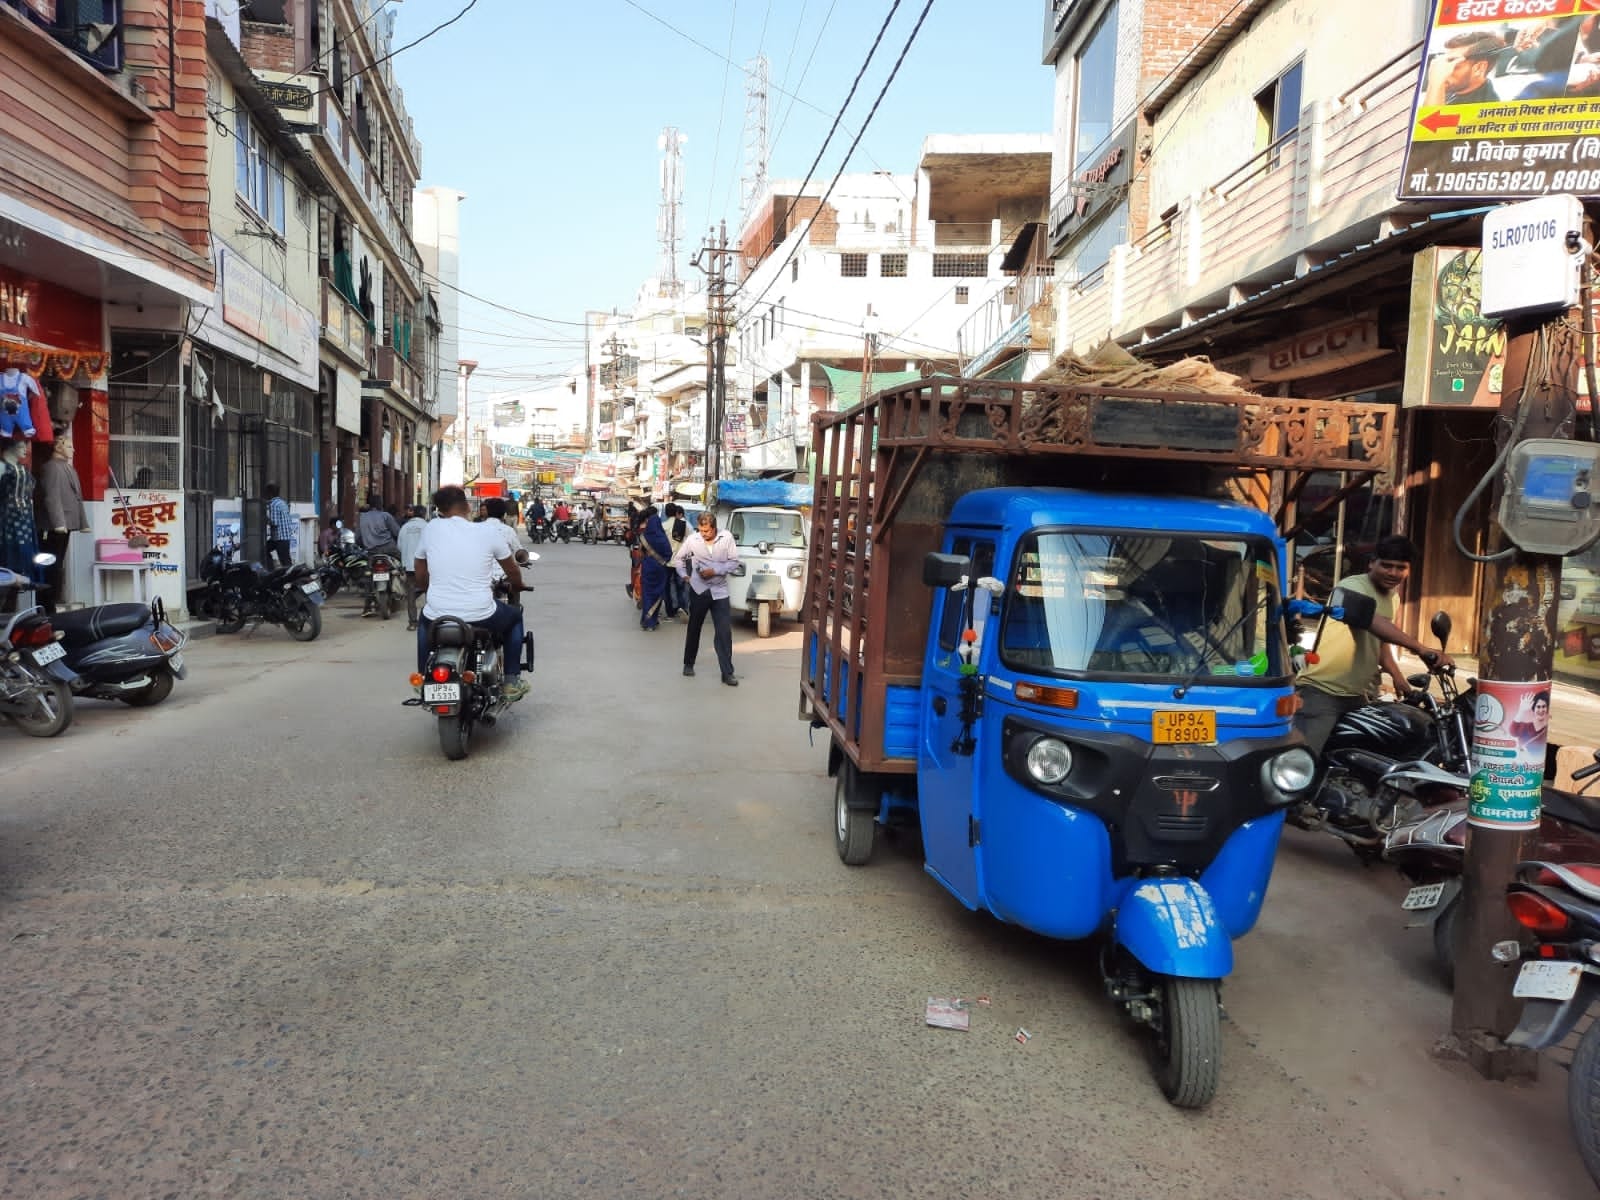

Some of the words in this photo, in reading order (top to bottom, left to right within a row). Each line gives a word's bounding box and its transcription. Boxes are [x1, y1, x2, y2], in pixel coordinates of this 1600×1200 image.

[1523, 142, 1571, 167] कुमार
[1492, 219, 1557, 250] 5LR070106
[112, 502, 177, 528] नाइस
[1168, 712, 1205, 727] UP94
[1165, 727, 1209, 742] T8903
